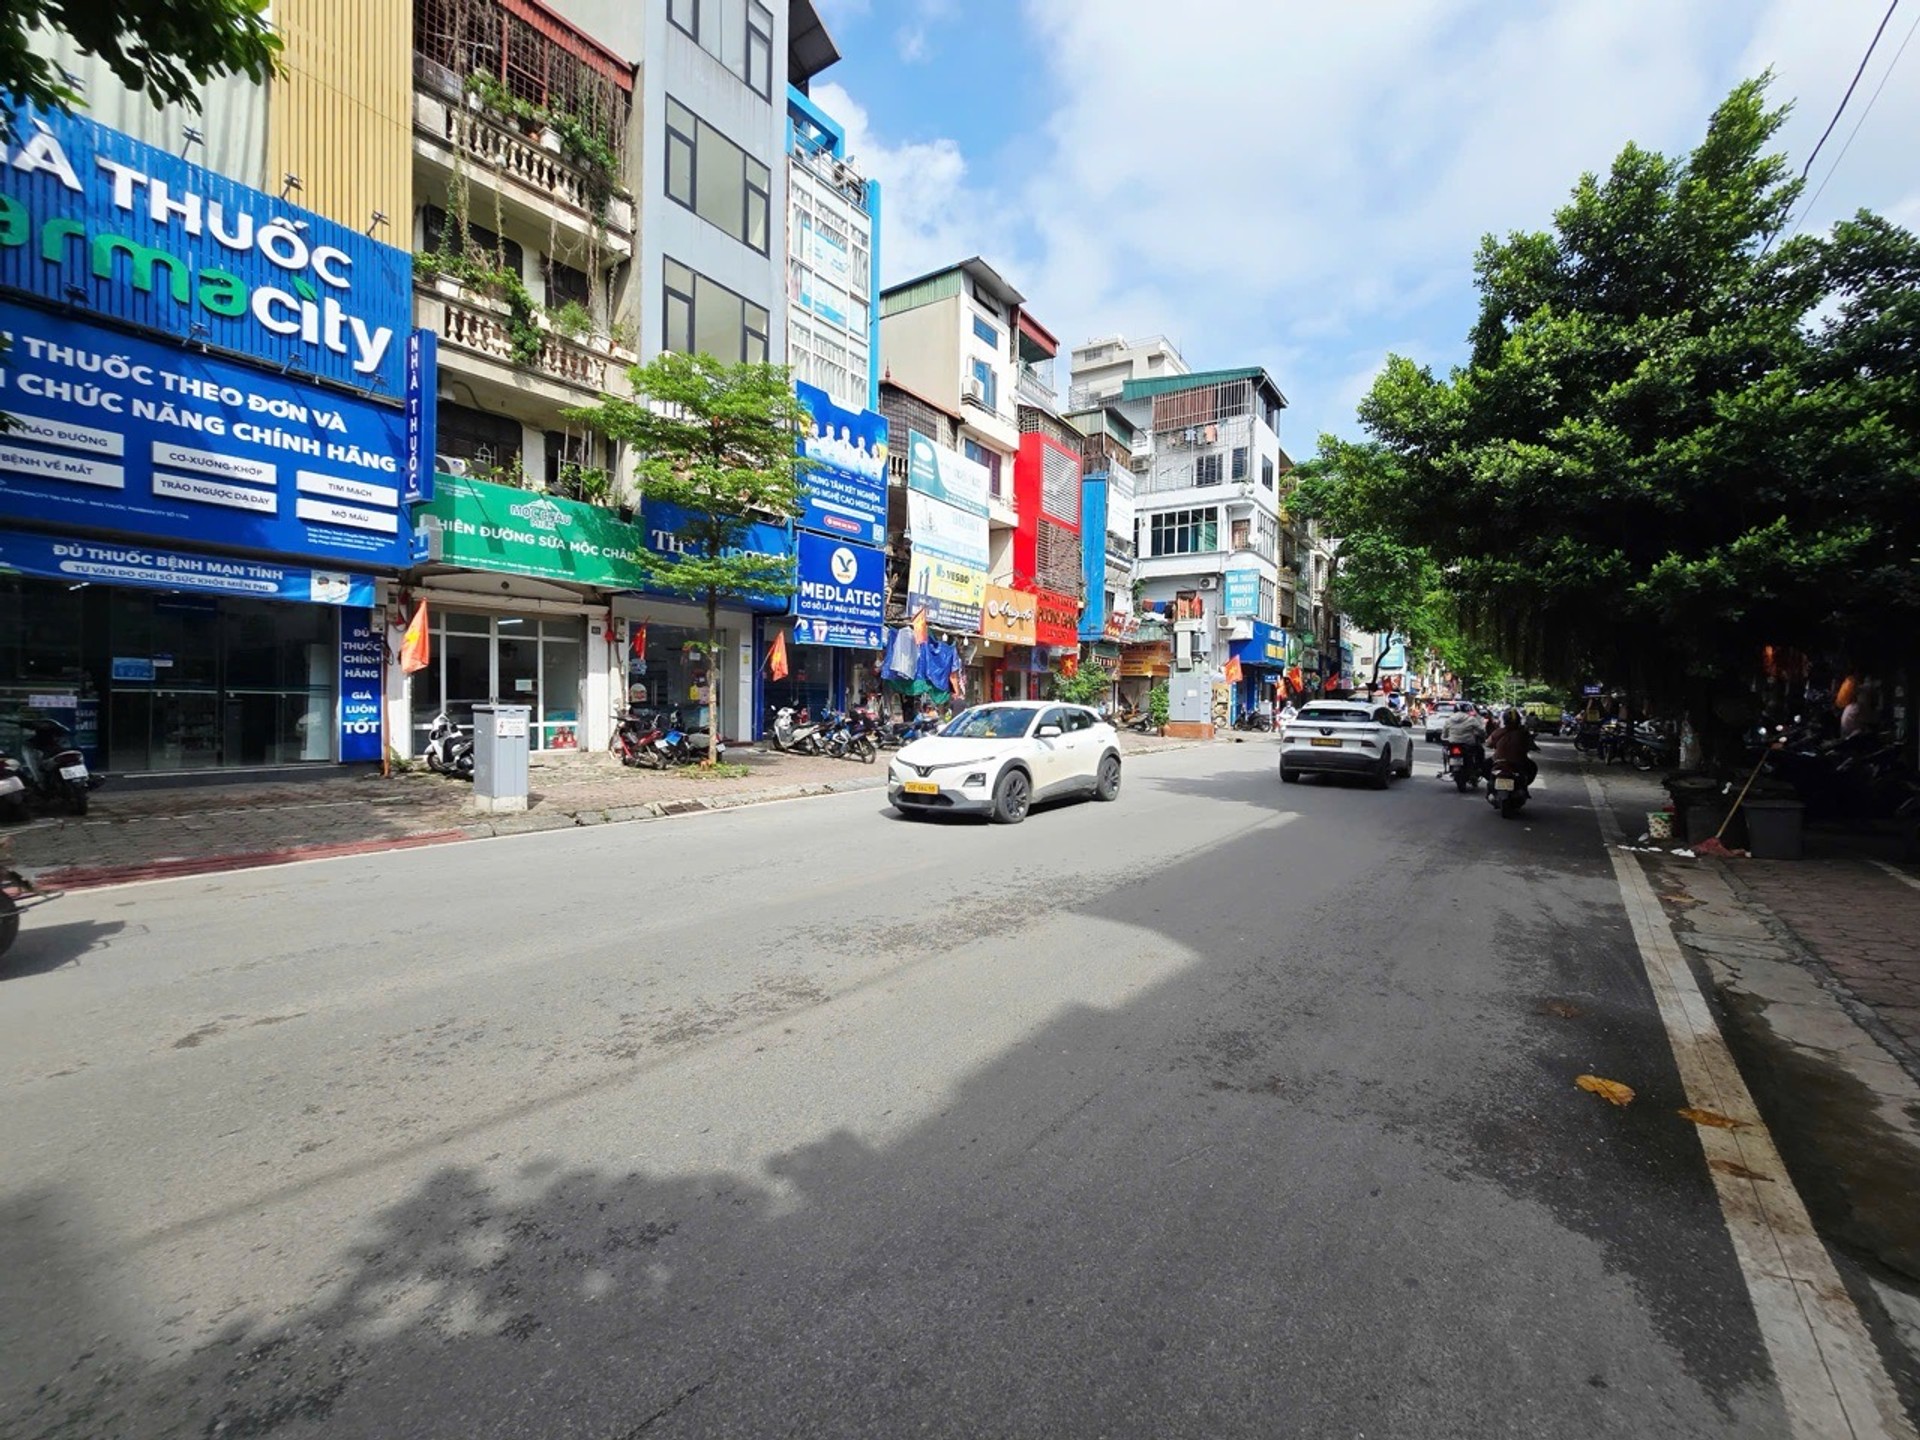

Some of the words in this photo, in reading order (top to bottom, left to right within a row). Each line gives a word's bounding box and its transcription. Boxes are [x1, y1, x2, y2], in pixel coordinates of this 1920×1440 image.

[95, 155, 353, 288] THUỐC
[409, 334, 419, 390] NHÀ
[22, 335, 154, 386] THUỐC
[159, 369, 243, 407] THEO
[247, 393, 307, 425] ĐƠN
[312, 407, 348, 434] VÀ
[17, 373, 124, 413] CHỨC
[132, 397, 225, 435] NĂNG
[232, 422, 320, 457] CHÍNH
[326, 442, 397, 473] HÃNG
[409, 398, 419, 489] THUỐC
[1, 453, 41, 467] BỆNH
[437, 518, 476, 536] HIÊN
[479, 527, 535, 545] ĐƯỜNG
[538, 534, 566, 550] SỮA
[569, 541, 599, 557] MỘC
[602, 548, 635, 561] CHÂU
[53, 543, 84, 558] ĐỦ
[86, 547, 153, 566] THUỐC
[156, 555, 203, 572] BỆNH
[206, 562, 245, 578] MẠN
[247, 565, 284, 581] TÍNH
[801, 580, 882, 608] MEDLATEC
[353, 628, 370, 638] ĐỦ
[813, 624, 828, 642] 17
[344, 666, 379, 679] HÃNG
[345, 703, 377, 714] LUÔN
[351, 690, 372, 700] GIÁ
[342, 717, 380, 735] TỐT
